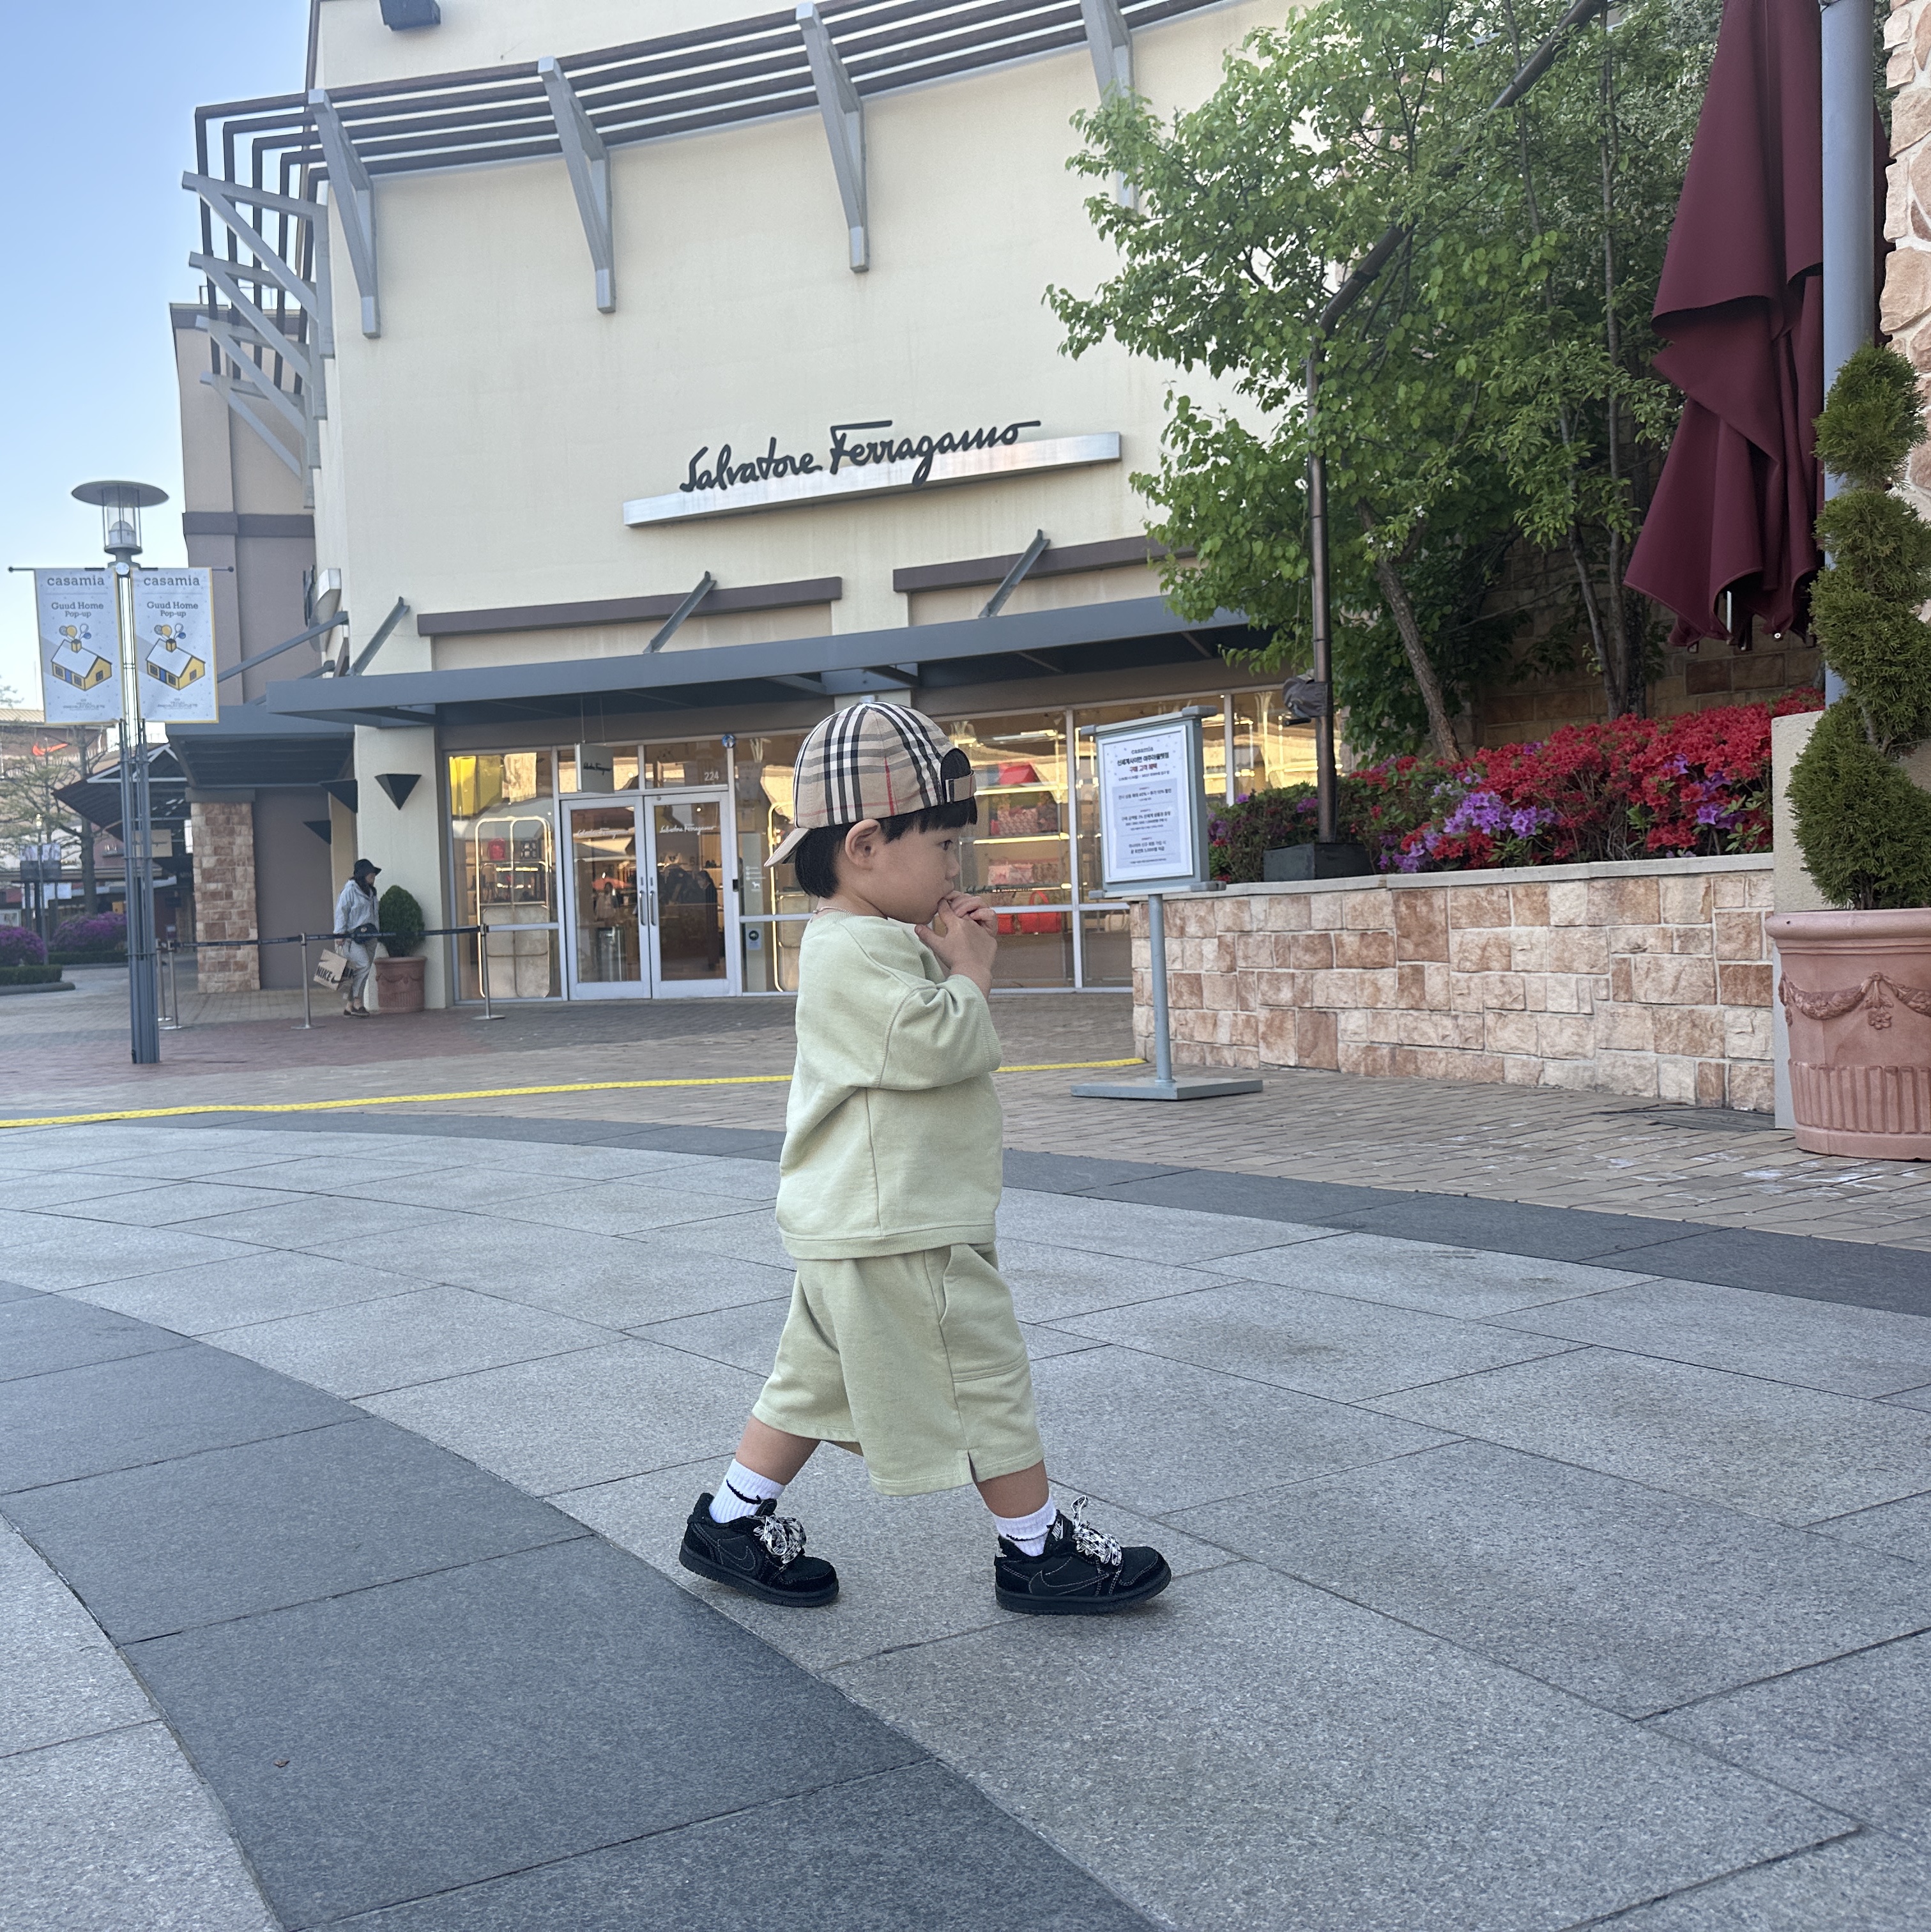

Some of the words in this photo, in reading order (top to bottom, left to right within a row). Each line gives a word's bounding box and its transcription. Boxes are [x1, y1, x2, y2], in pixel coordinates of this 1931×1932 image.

[680, 436, 823, 492] Salvatore
[830, 420, 1041, 487] Ferragamo
[47, 575, 105, 586] casamia
[144, 575, 200, 586] casamia
[51, 602, 76, 610] Guud
[77, 602, 104, 610] Home
[147, 601, 171, 610] Guud
[172, 601, 199, 610] Home
[1131, 746, 1154, 755] casamia
[704, 770, 719, 781] 224
[316, 965, 333, 981] NIKE
